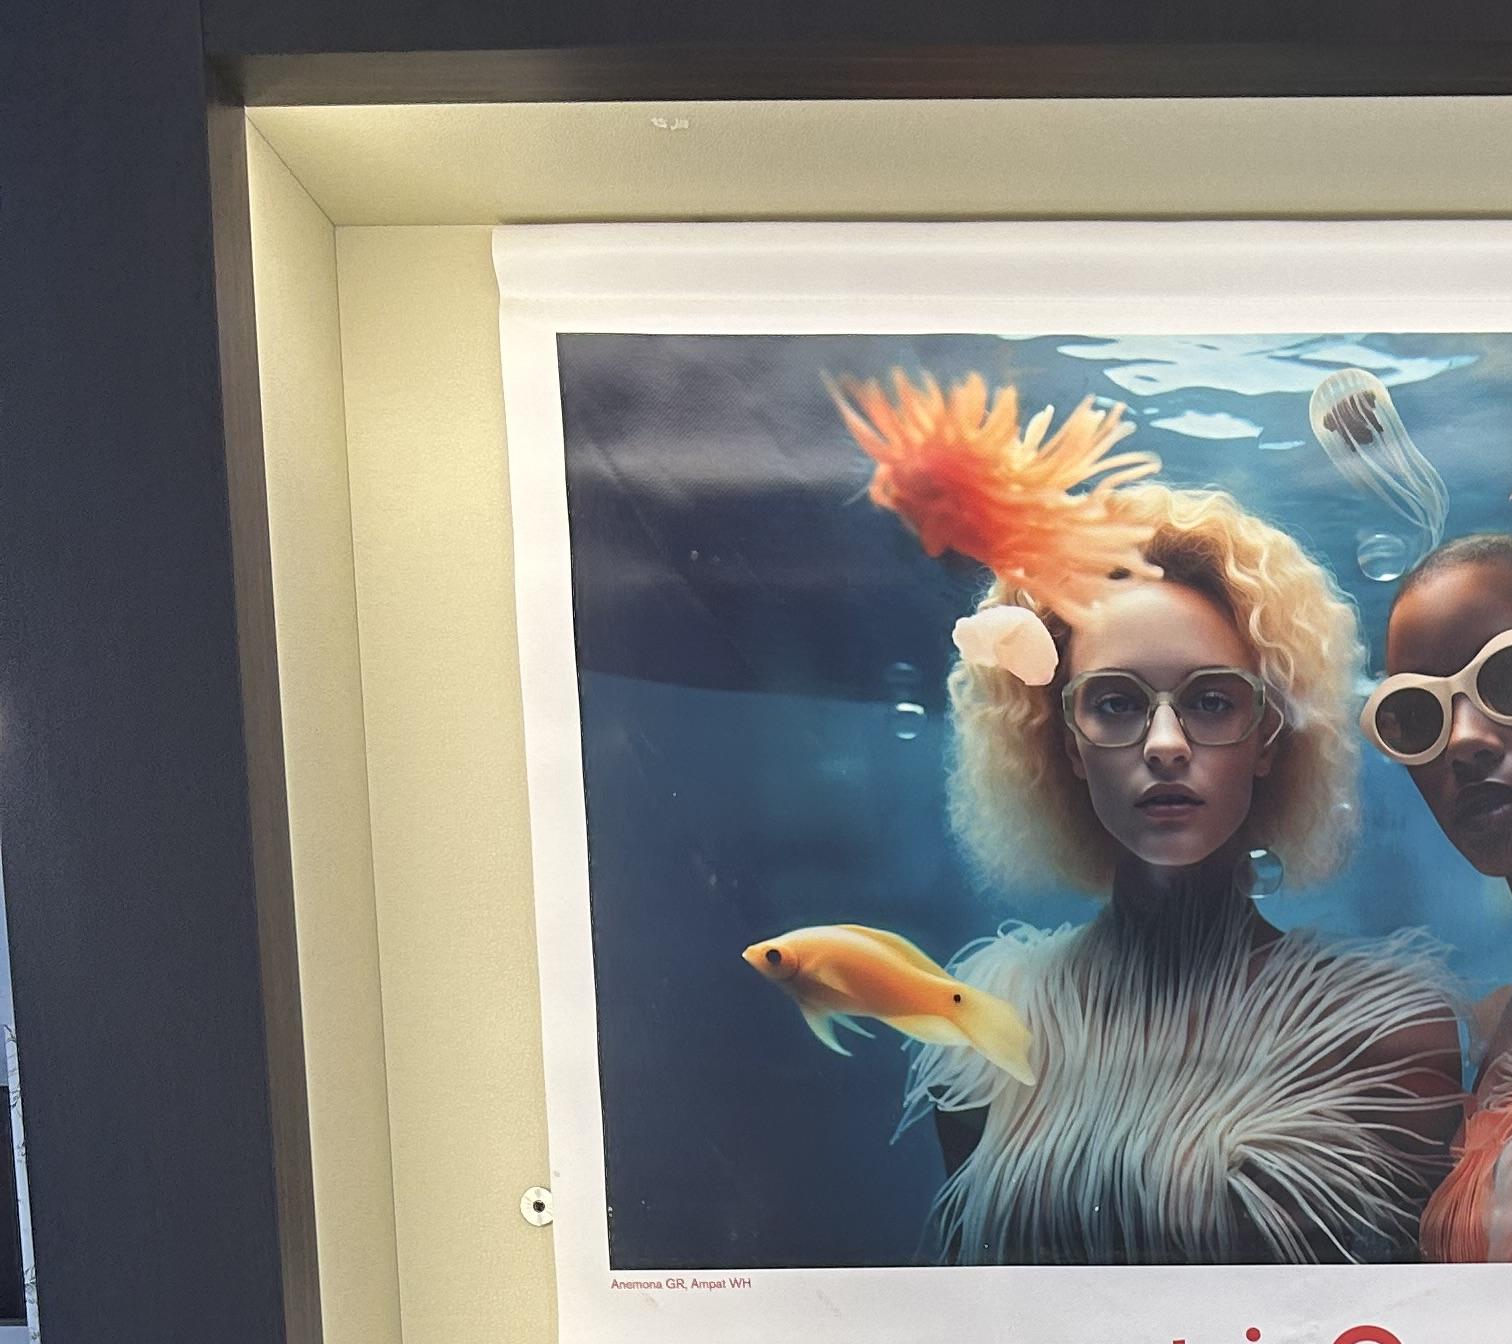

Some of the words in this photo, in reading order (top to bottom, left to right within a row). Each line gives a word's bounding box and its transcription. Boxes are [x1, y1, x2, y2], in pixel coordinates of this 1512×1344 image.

[611, 1278, 662, 1289] Anemona
[665, 1278, 688, 1291] GR,
[691, 1277, 726, 1291] Ampat
[729, 1277, 751, 1288] WH
